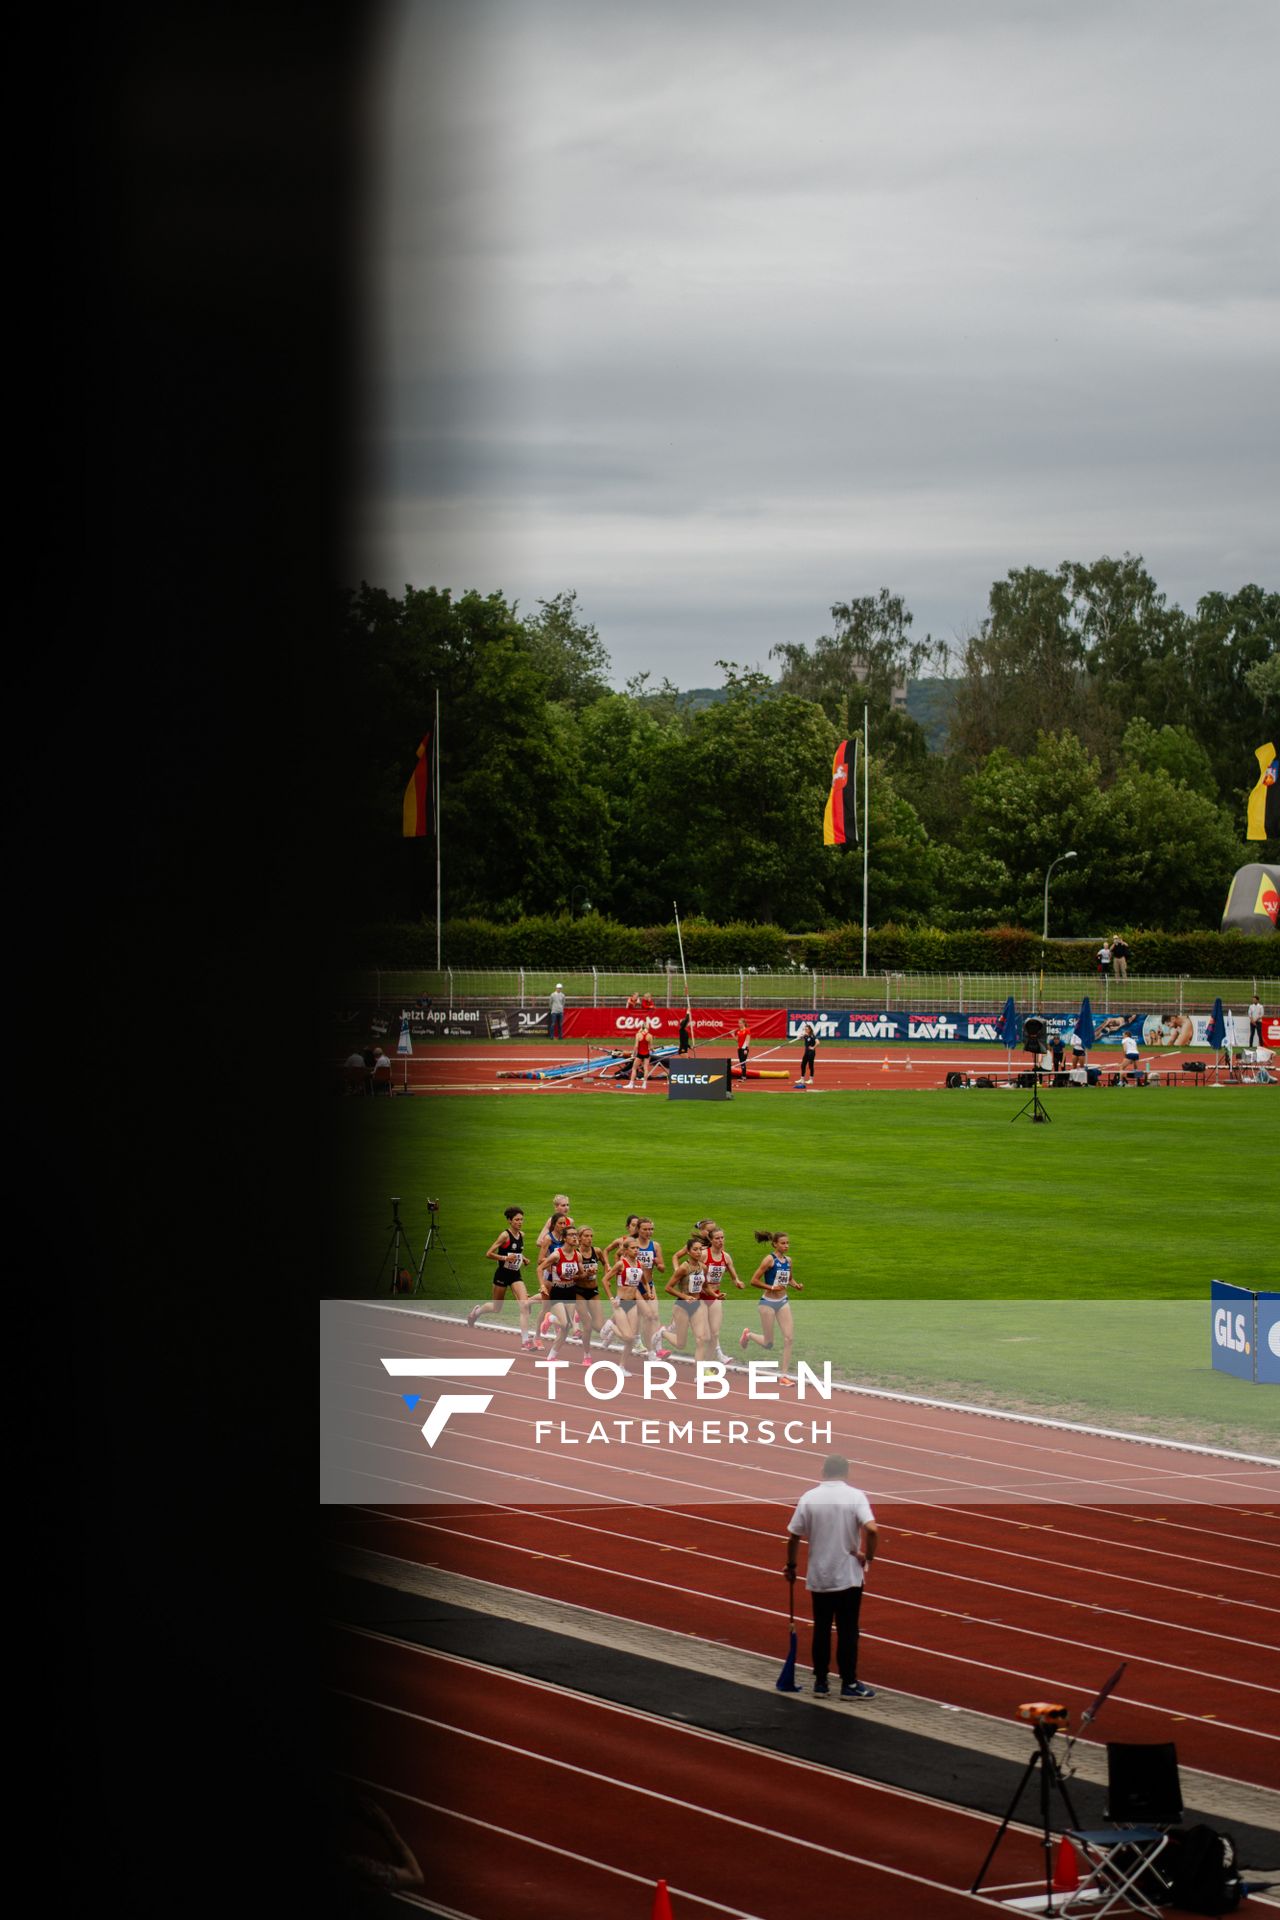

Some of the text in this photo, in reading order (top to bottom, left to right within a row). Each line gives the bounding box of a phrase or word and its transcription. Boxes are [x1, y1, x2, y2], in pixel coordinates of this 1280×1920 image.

[400, 1009, 479, 1023] Jetzt App laden!
[790, 1013, 818, 1021] SPORT
[849, 1014, 878, 1022] SPORT
[908, 1015, 937, 1023] SPORT
[967, 1016, 997, 1024] SPORT
[696, 1019, 723, 1028] photos
[670, 1074, 708, 1085] SELTEC
